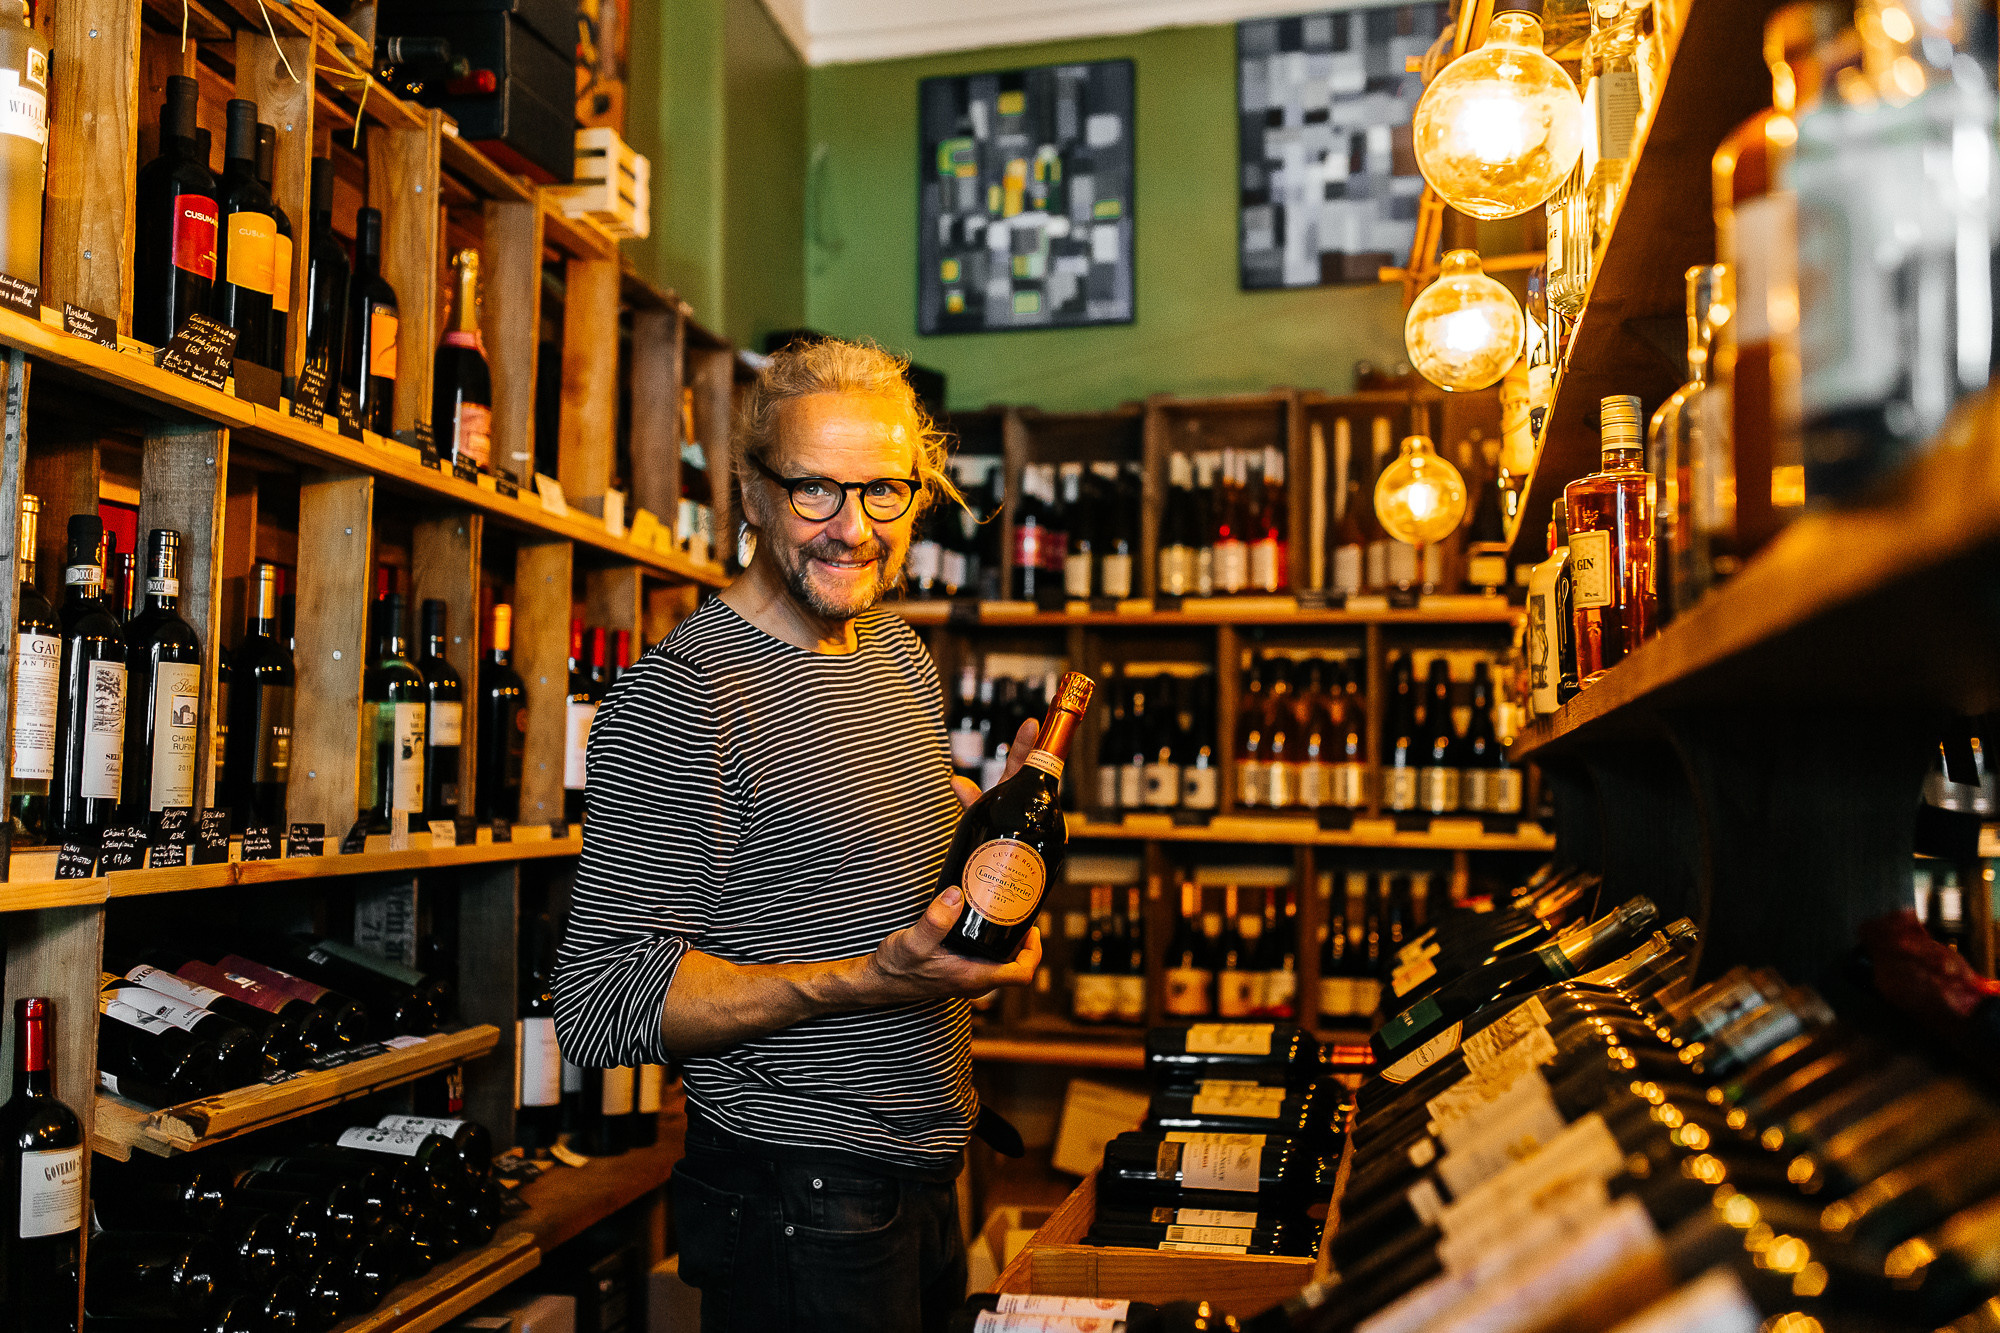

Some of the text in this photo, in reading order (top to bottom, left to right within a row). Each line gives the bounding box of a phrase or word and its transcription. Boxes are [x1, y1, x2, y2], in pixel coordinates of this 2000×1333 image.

[1577, 557, 1594, 571] GIN
[996, 861, 1028, 879] CHAMPAGNE
[978, 868, 1031, 898] Laurent-Perrier
